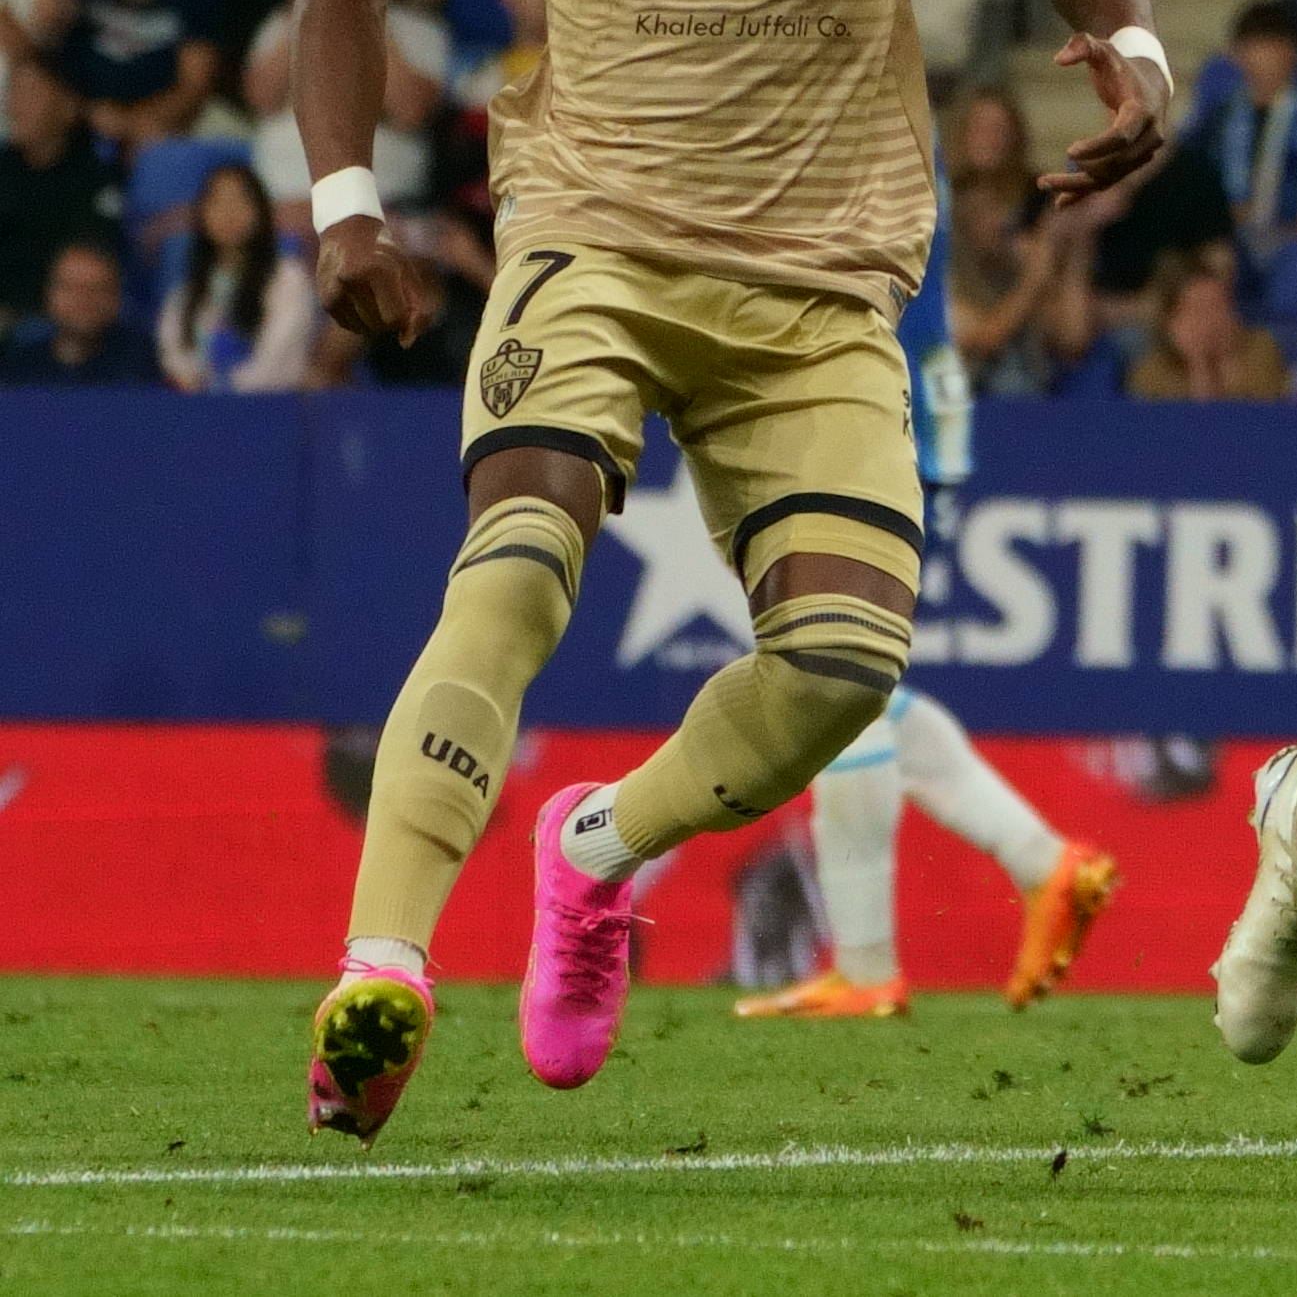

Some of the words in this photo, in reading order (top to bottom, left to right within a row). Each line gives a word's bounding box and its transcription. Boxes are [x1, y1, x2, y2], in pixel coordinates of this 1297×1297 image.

[634, 13, 726, 37] Khaled
[735, 14, 811, 38] Juffali
[817, 14, 852, 38] Co.
[499, 249, 577, 333] 7
[485, 361, 498, 374] U
[517, 353, 533, 364] D
[483, 369, 530, 386] ALMERIA
[421, 731, 490, 800] UDA
